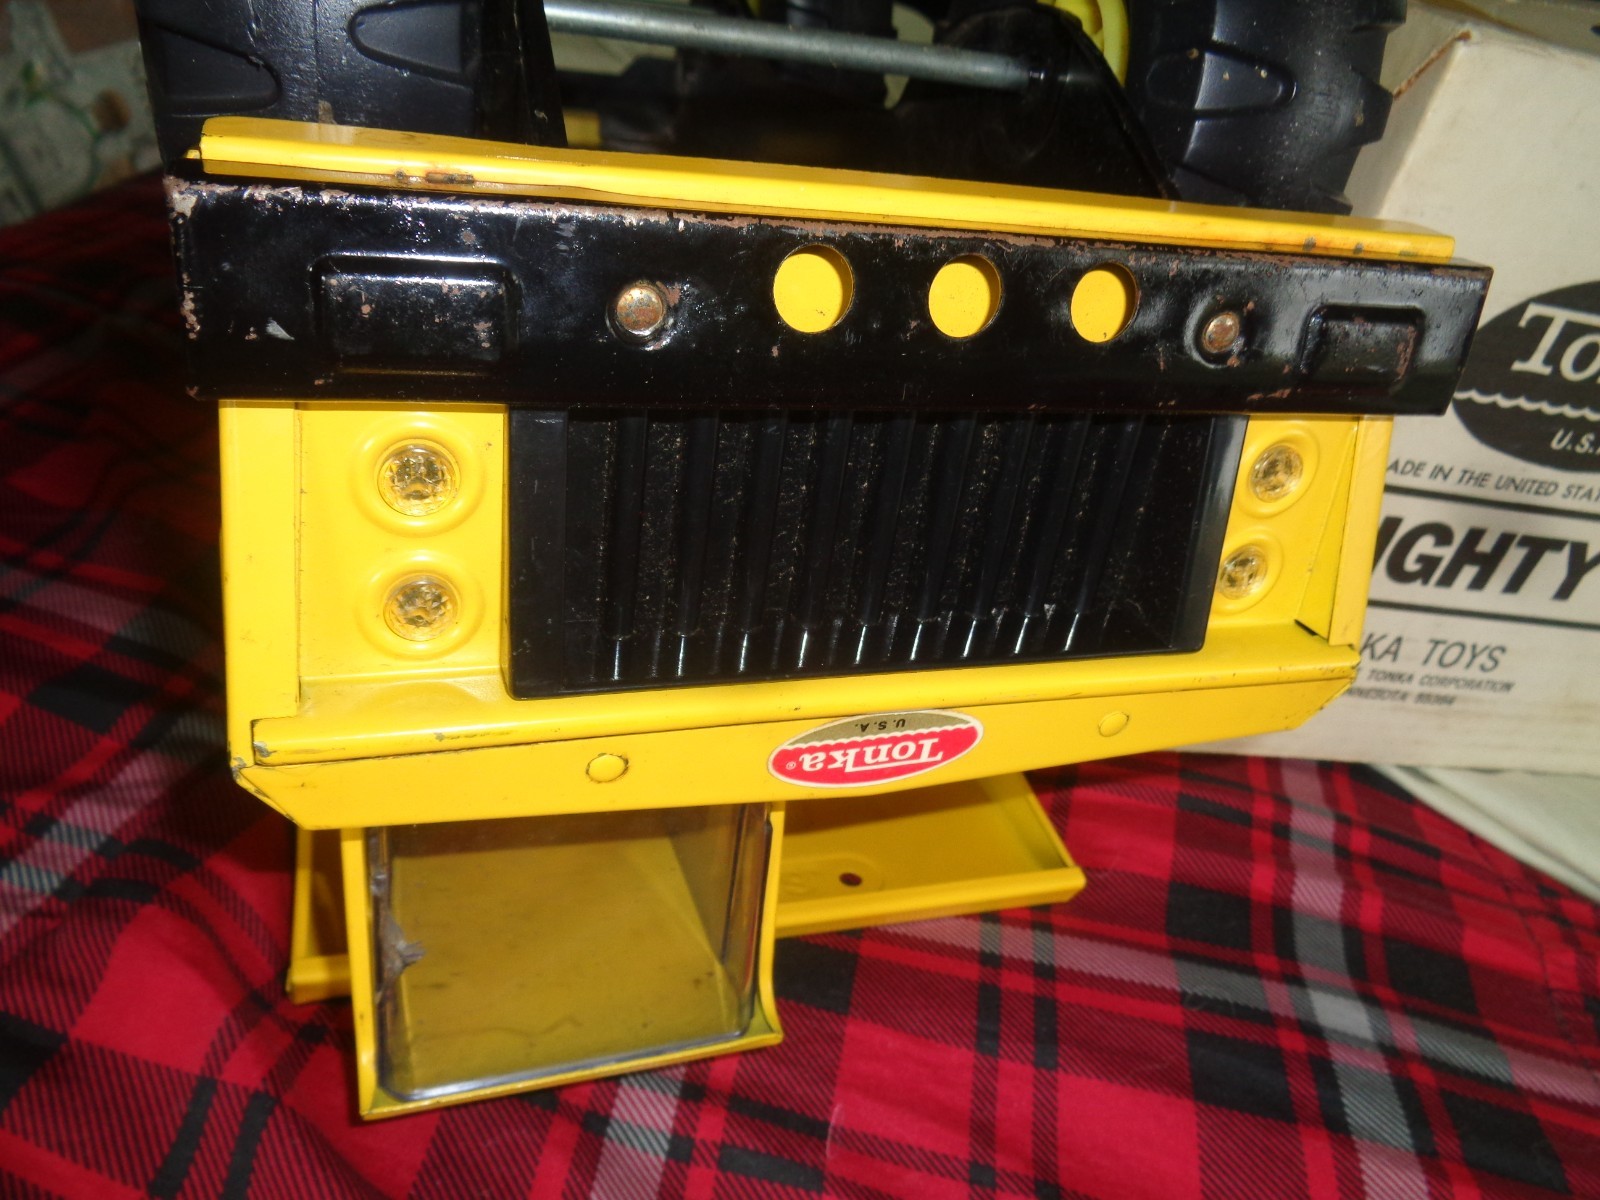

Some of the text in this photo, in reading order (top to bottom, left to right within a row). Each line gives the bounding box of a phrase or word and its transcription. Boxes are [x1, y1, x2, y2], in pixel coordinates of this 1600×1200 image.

[1510, 302, 1600, 384] To
[1551, 428, 1600, 455] U.S.
[1385, 459, 1427, 477] ADE
[1429, 464, 1453, 482] IN
[1457, 469, 1492, 488] THE
[1494, 474, 1559, 497] UNITED
[1372, 516, 1600, 601] IGHTY
[1359, 633, 1507, 673] KA TOYS
[1368, 668, 1516, 693] TONKA CORPORATION
